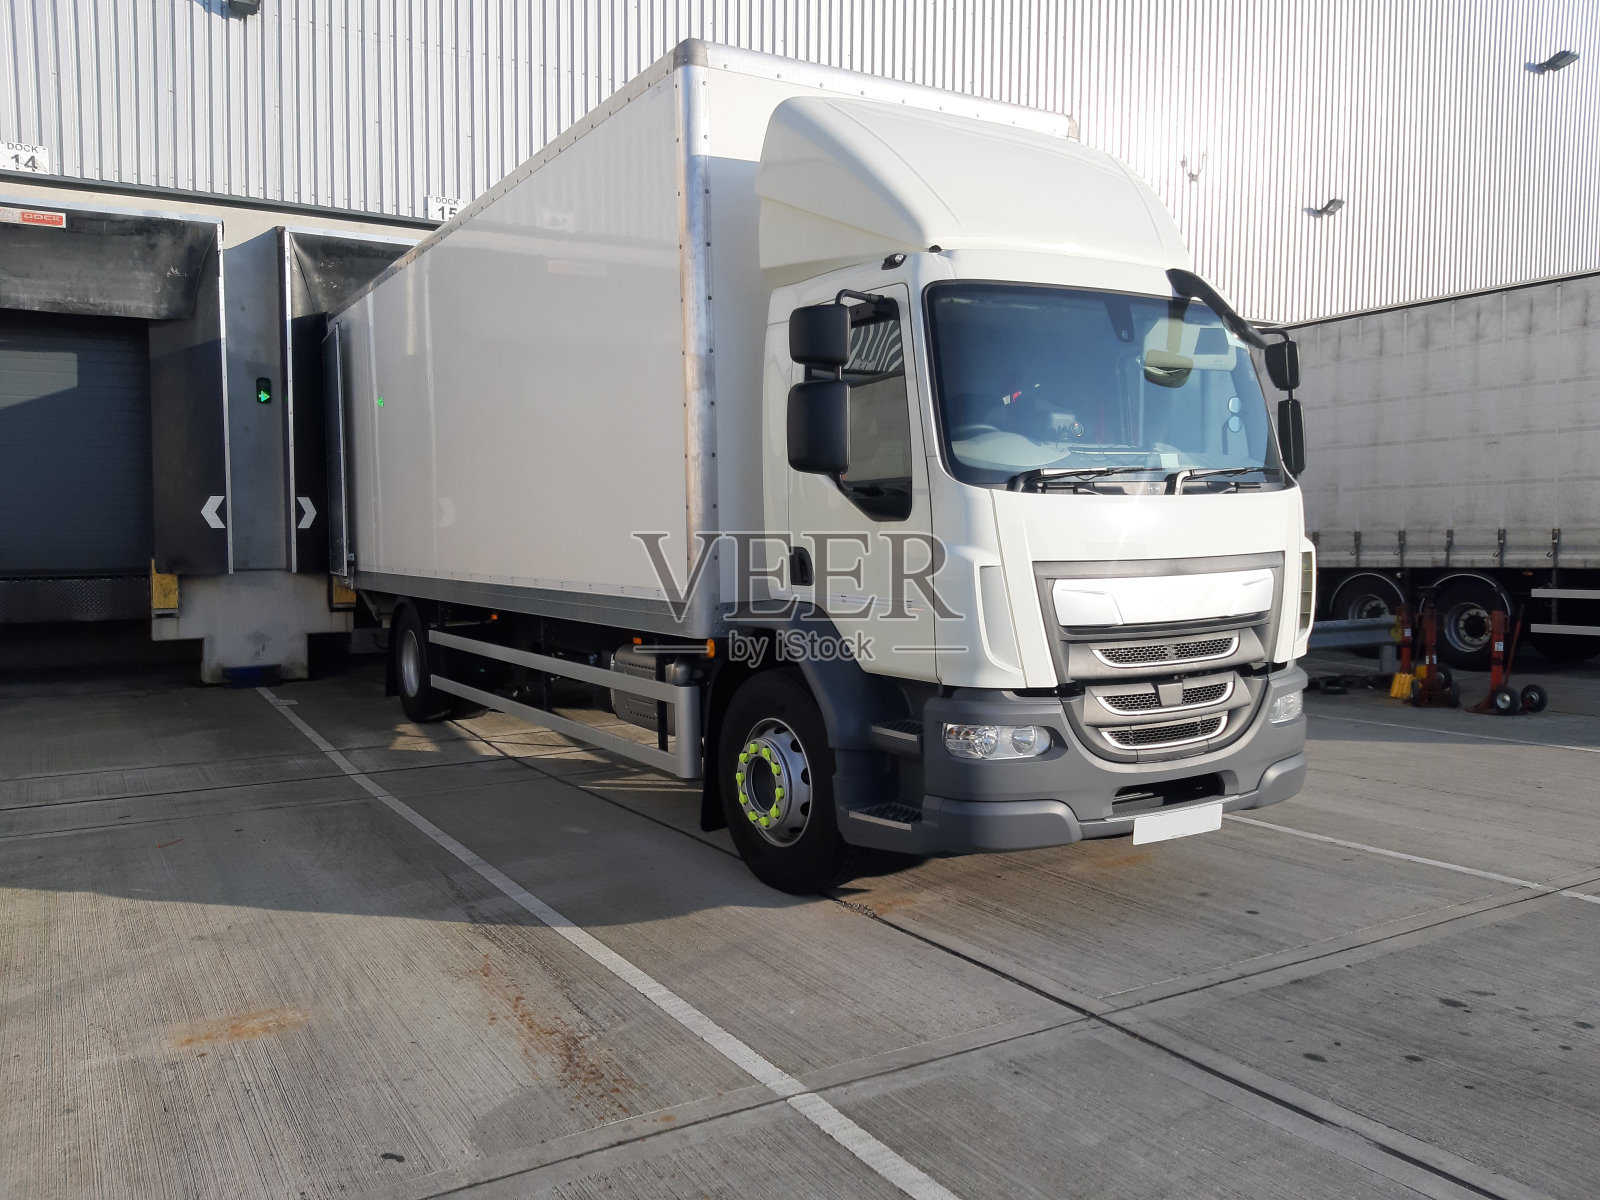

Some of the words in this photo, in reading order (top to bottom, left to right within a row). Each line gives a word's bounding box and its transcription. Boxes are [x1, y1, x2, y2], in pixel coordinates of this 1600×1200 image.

[7, 142, 39, 153] DOCK
[10, 154, 38, 172] 14
[436, 197, 458, 205] DOCK
[24, 214, 61, 222] DOCK
[438, 206, 457, 220] 15
